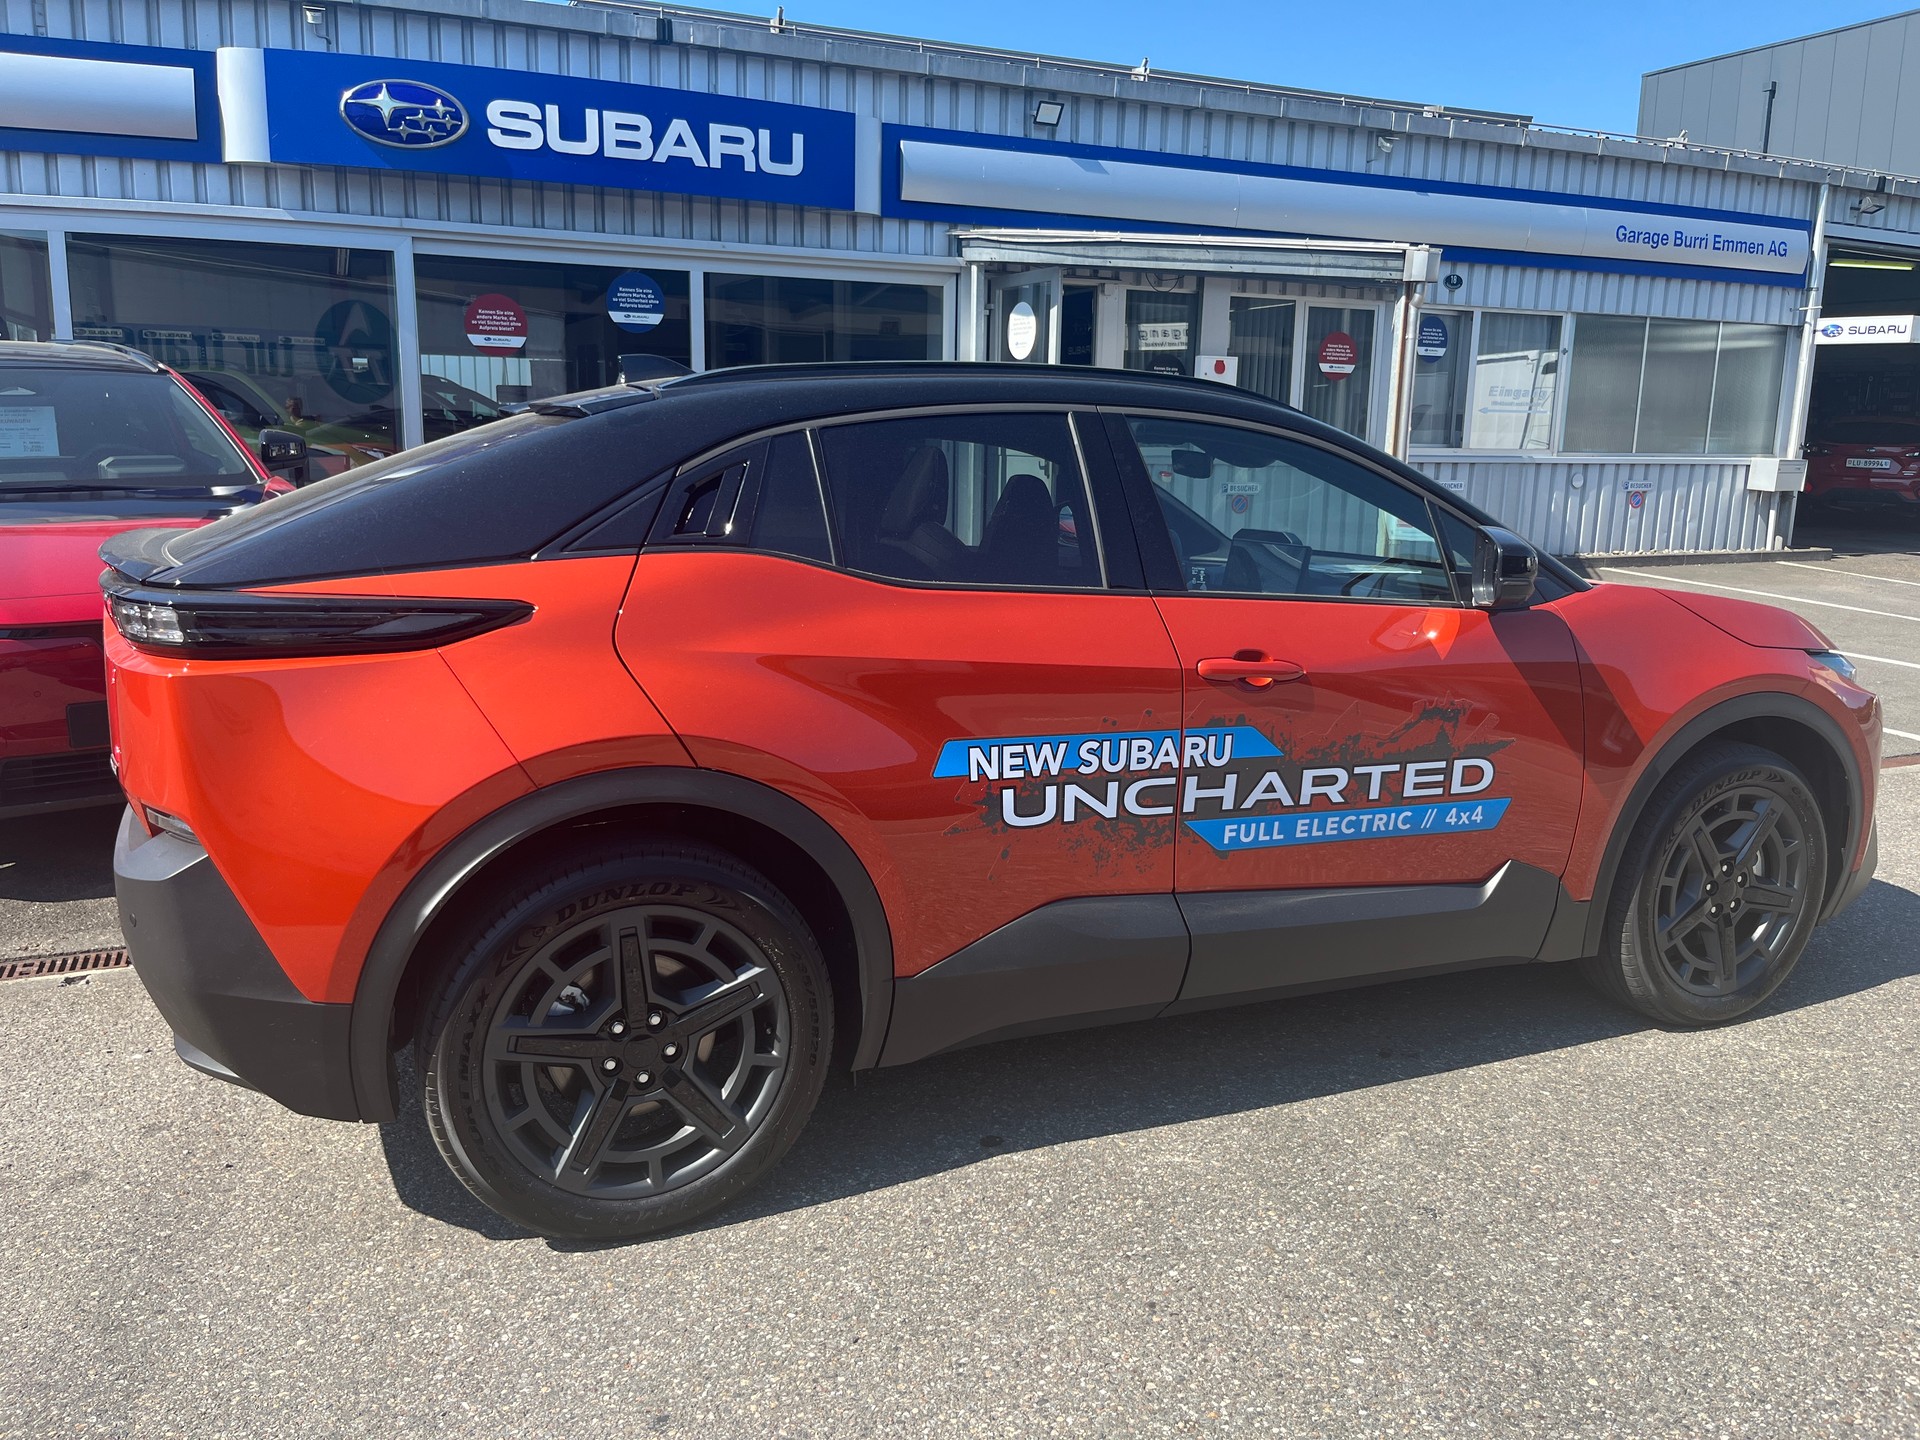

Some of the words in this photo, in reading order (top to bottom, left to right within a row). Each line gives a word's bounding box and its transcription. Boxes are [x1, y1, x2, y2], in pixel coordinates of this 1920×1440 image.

[486, 99, 804, 177] SUBARU
[1615, 225, 1669, 249] Garage
[1673, 230, 1709, 250] Burri
[1712, 234, 1765, 256] Emmen
[1767, 240, 1788, 258] AG
[1848, 324, 1907, 335] SUBARU
[968, 742, 1068, 783] NEW
[1077, 733, 1235, 775] SUBARU
[1001, 756, 1496, 828] UNCHARTED
[1693, 770, 1762, 811] DUNLOP
[1223, 820, 1285, 845] FULL
[1295, 811, 1412, 839] ELECTRIC
[1444, 806, 1484, 827] 4x4
[555, 881, 696, 925] DUNLOP
